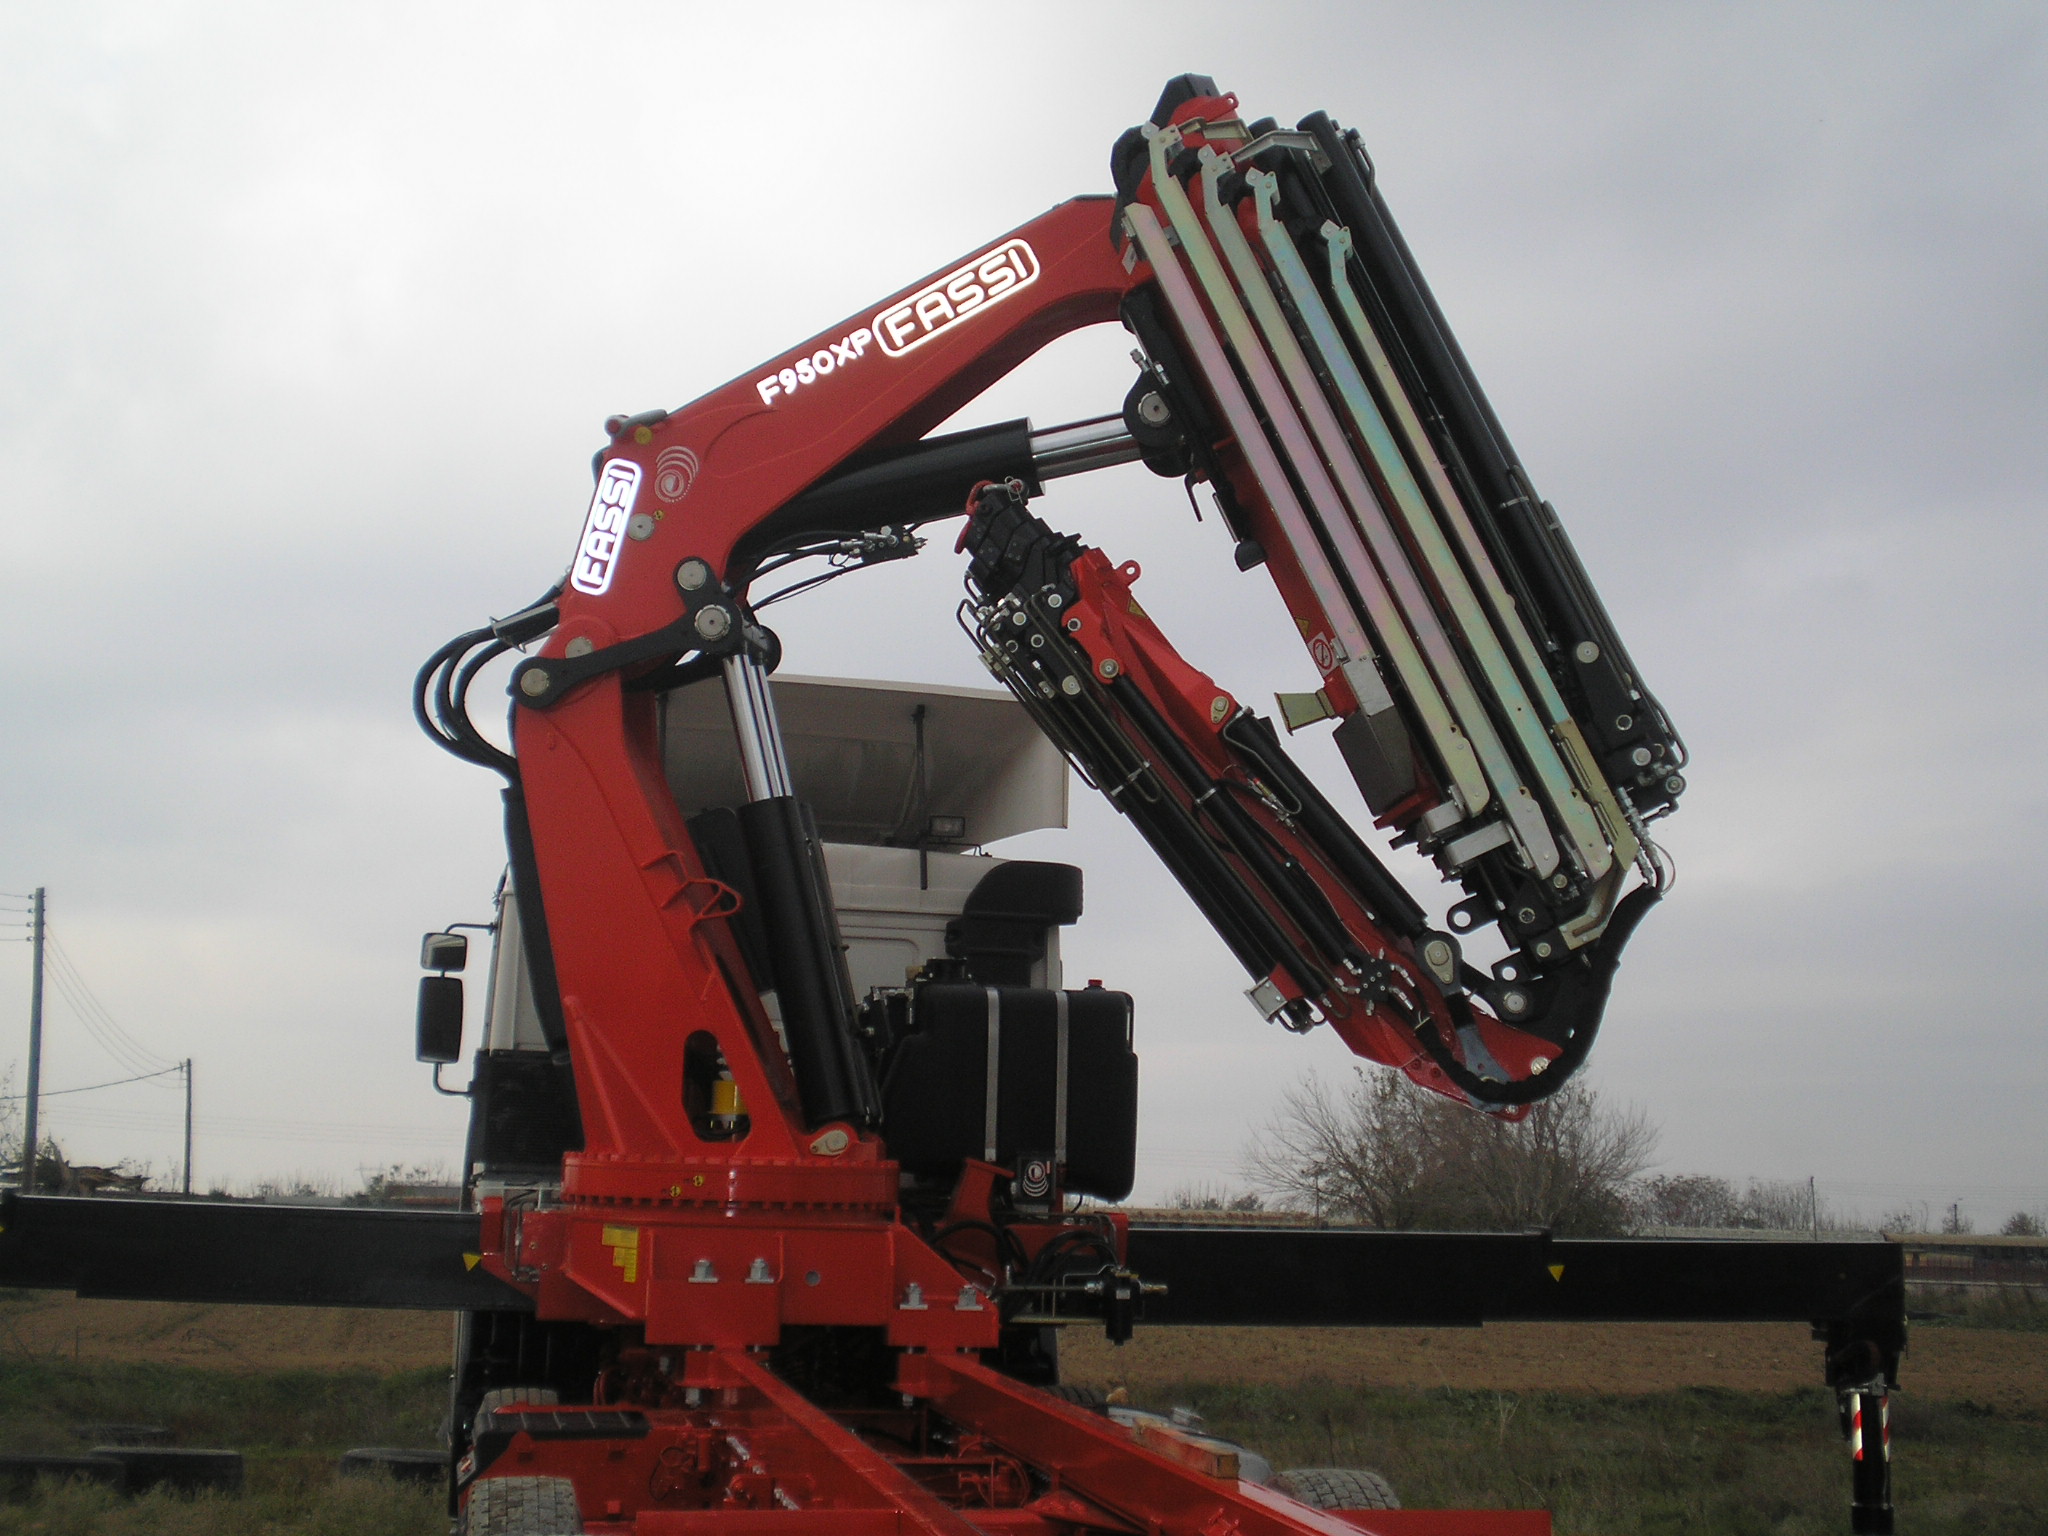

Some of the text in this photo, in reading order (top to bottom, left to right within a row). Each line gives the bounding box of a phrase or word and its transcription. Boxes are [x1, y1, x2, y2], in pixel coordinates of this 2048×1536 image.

[756, 248, 1028, 406] F950XP FASSI
[577, 468, 635, 586] FASSI
